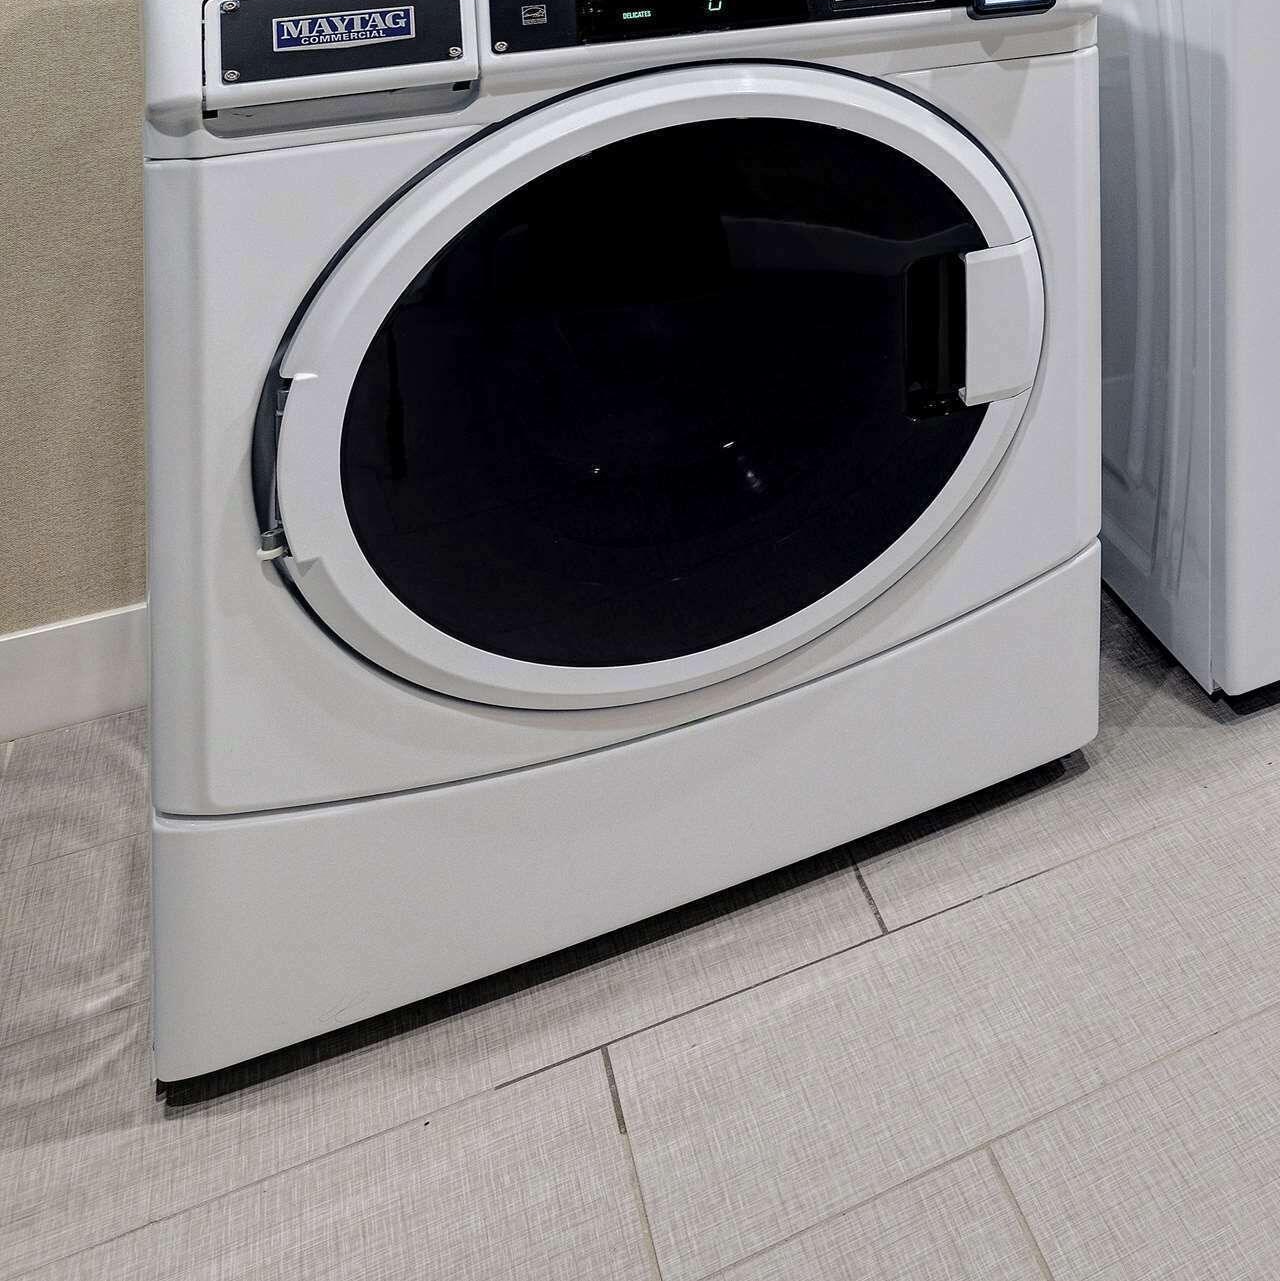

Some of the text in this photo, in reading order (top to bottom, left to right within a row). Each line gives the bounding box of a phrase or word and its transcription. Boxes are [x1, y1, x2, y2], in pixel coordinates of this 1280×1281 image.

[622, 10, 651, 19] DELICATES
[280, 10, 408, 41] MAYTAG
[300, 28, 386, 47] COMMERCIAL
